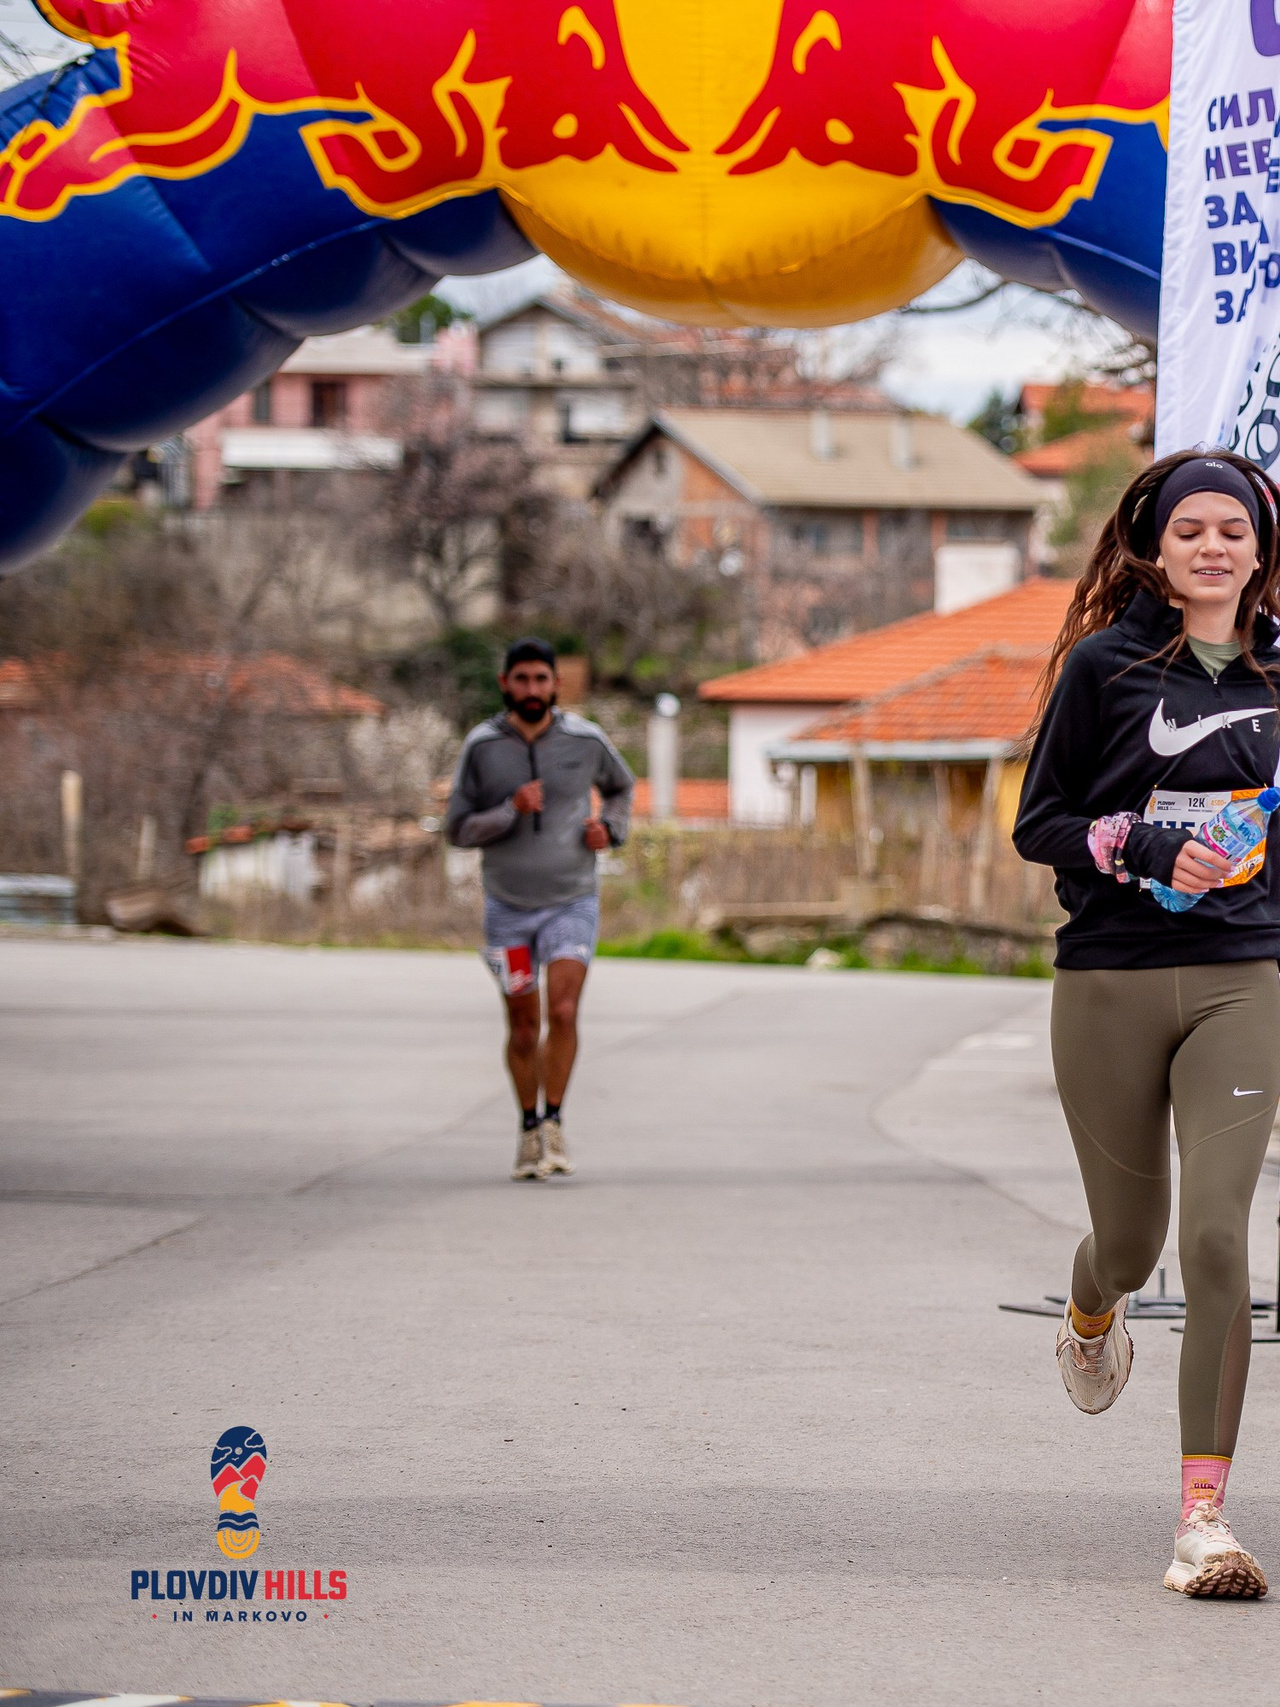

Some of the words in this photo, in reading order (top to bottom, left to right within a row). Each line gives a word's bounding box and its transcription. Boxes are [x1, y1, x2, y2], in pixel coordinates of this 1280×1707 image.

[1205, 461, 1223, 469] alo
[1166, 714, 1261, 733] NIKE
[1188, 797, 1205, 808] 12K
